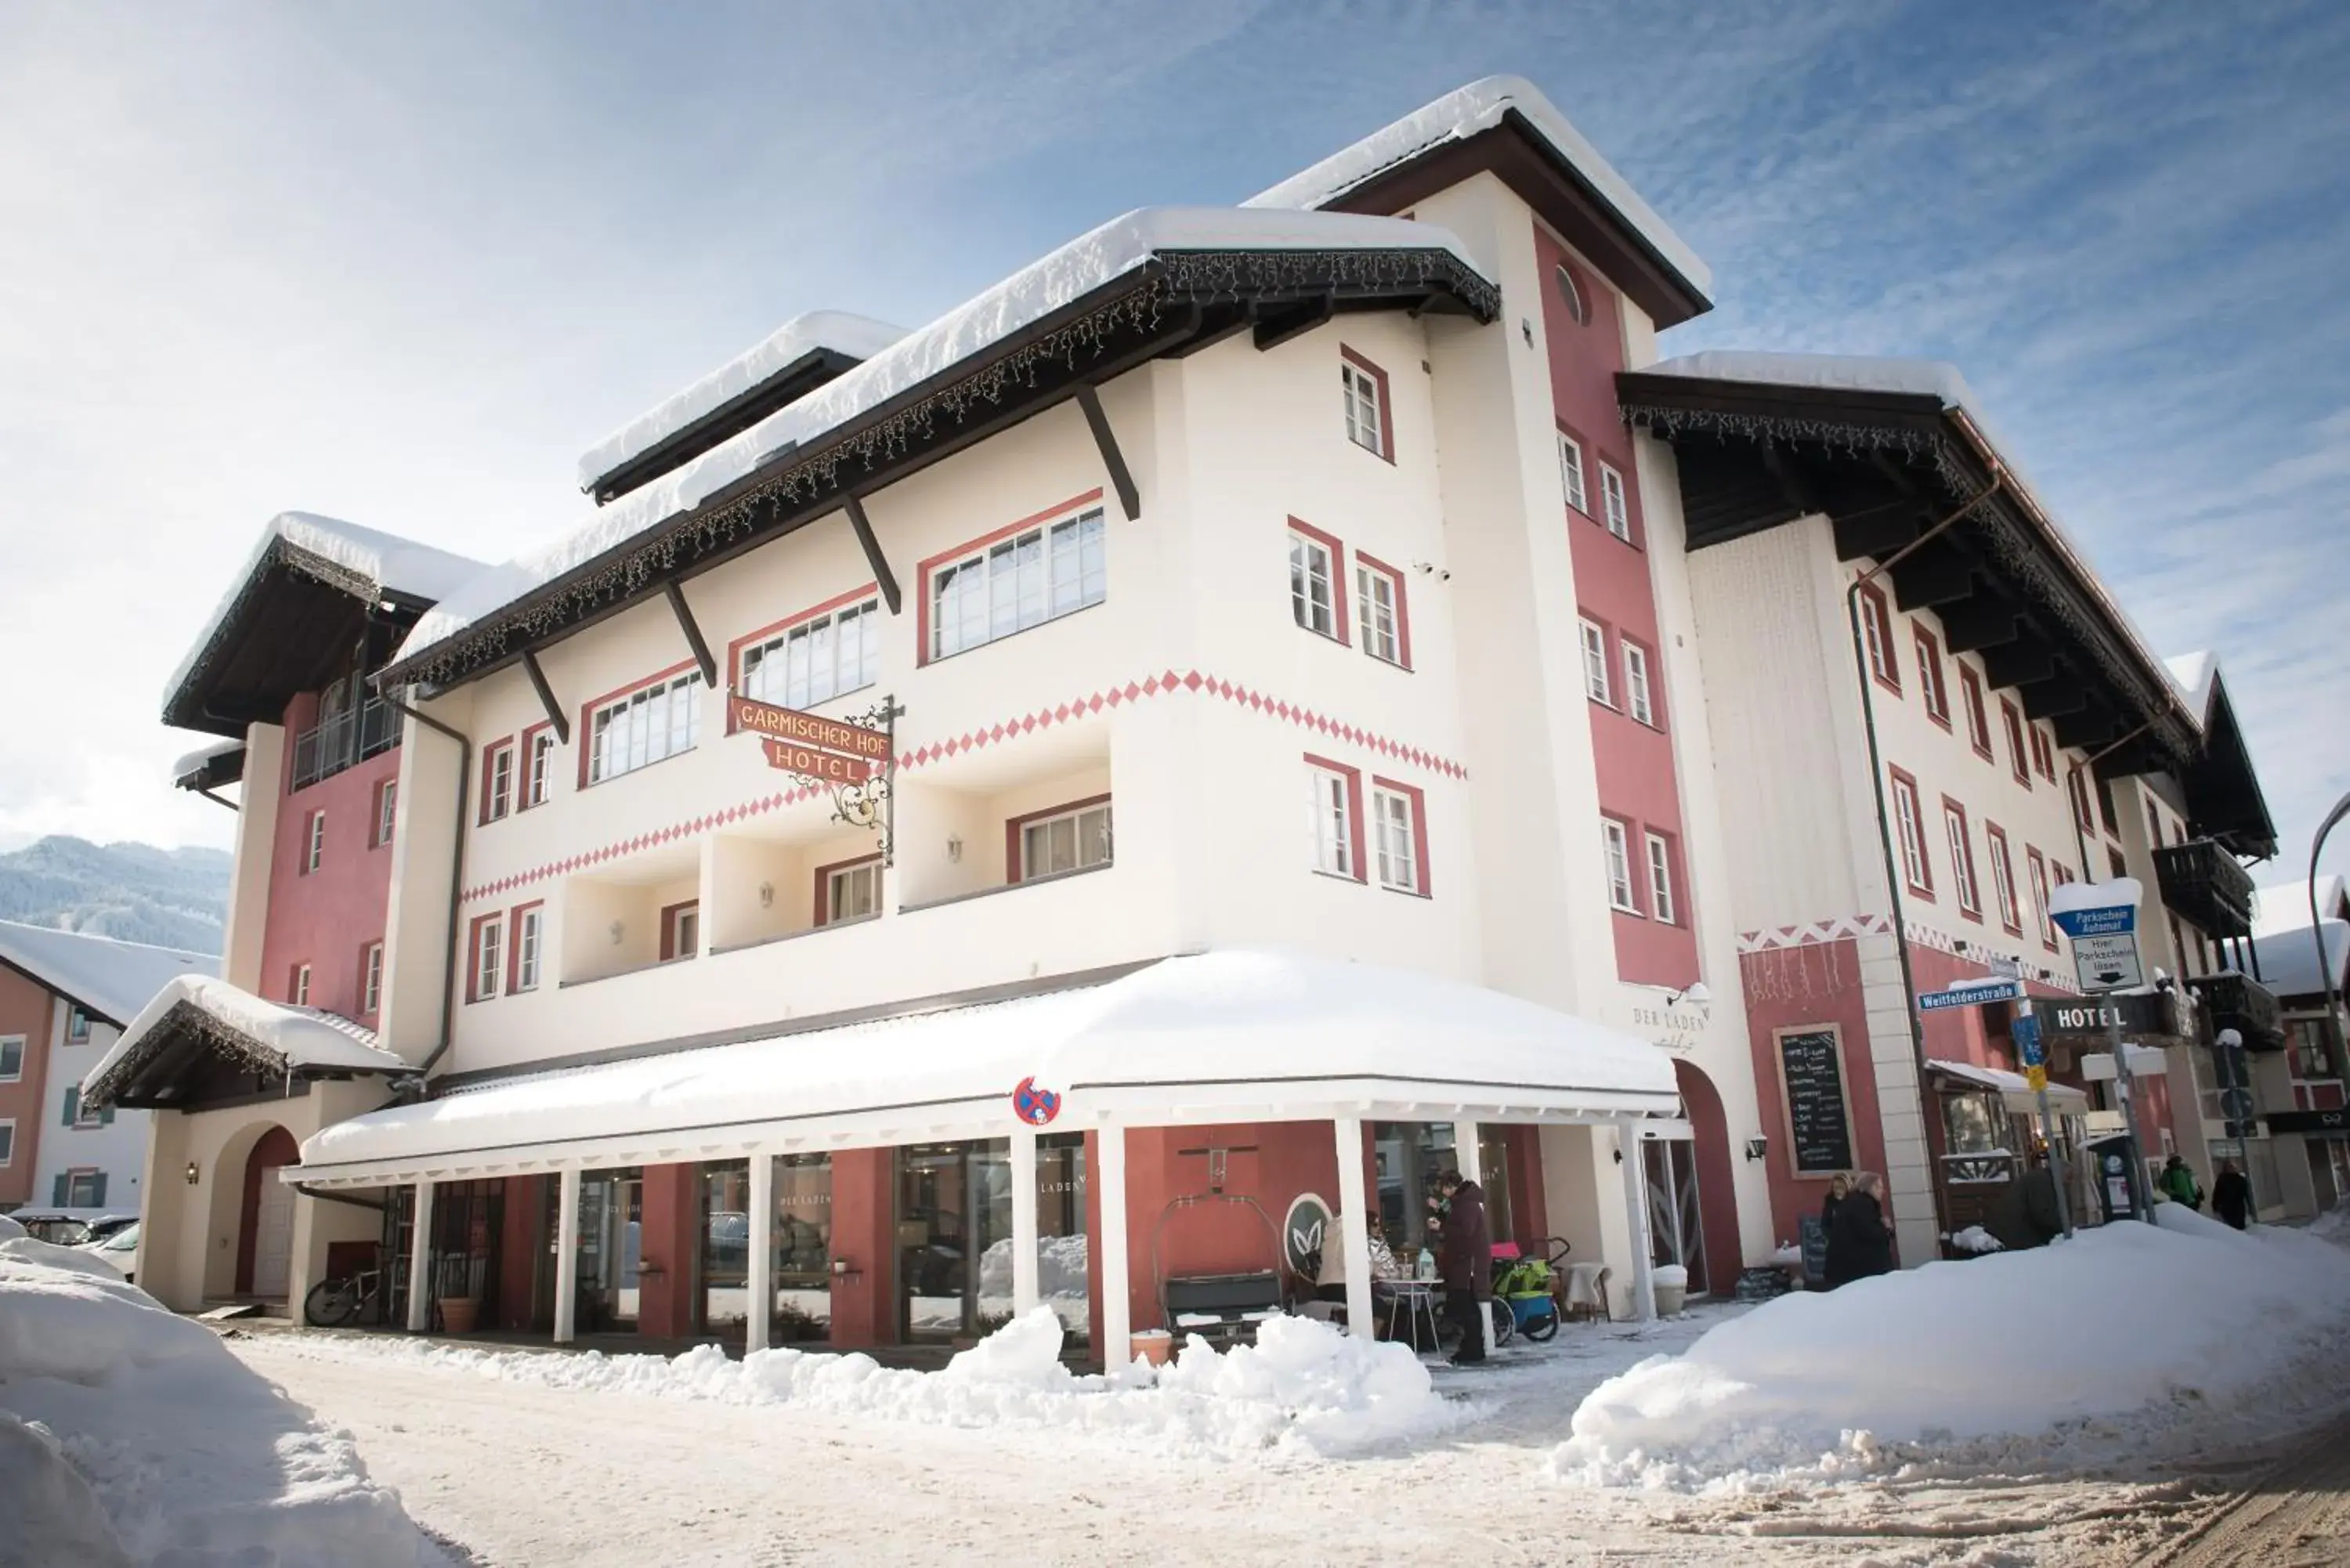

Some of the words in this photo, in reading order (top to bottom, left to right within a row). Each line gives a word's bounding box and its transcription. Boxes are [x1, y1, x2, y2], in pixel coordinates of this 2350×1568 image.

[741, 705, 851, 748] GARMISCHER
[857, 735, 888, 755] HOF
[776, 745, 859, 781] HOTEL
[2076, 909, 2128, 923] Parkschein
[2082, 921, 2121, 933] Automat
[2077, 947, 2135, 960] Parkschein
[1922, 985, 2013, 1008] Weitfelderstraße
[1633, 1007, 1659, 1026] DER
[1664, 1012, 1705, 1031] LADEN
[2057, 1007, 2127, 1028] HOTEL
[1041, 1181, 1079, 1194] LADEN
